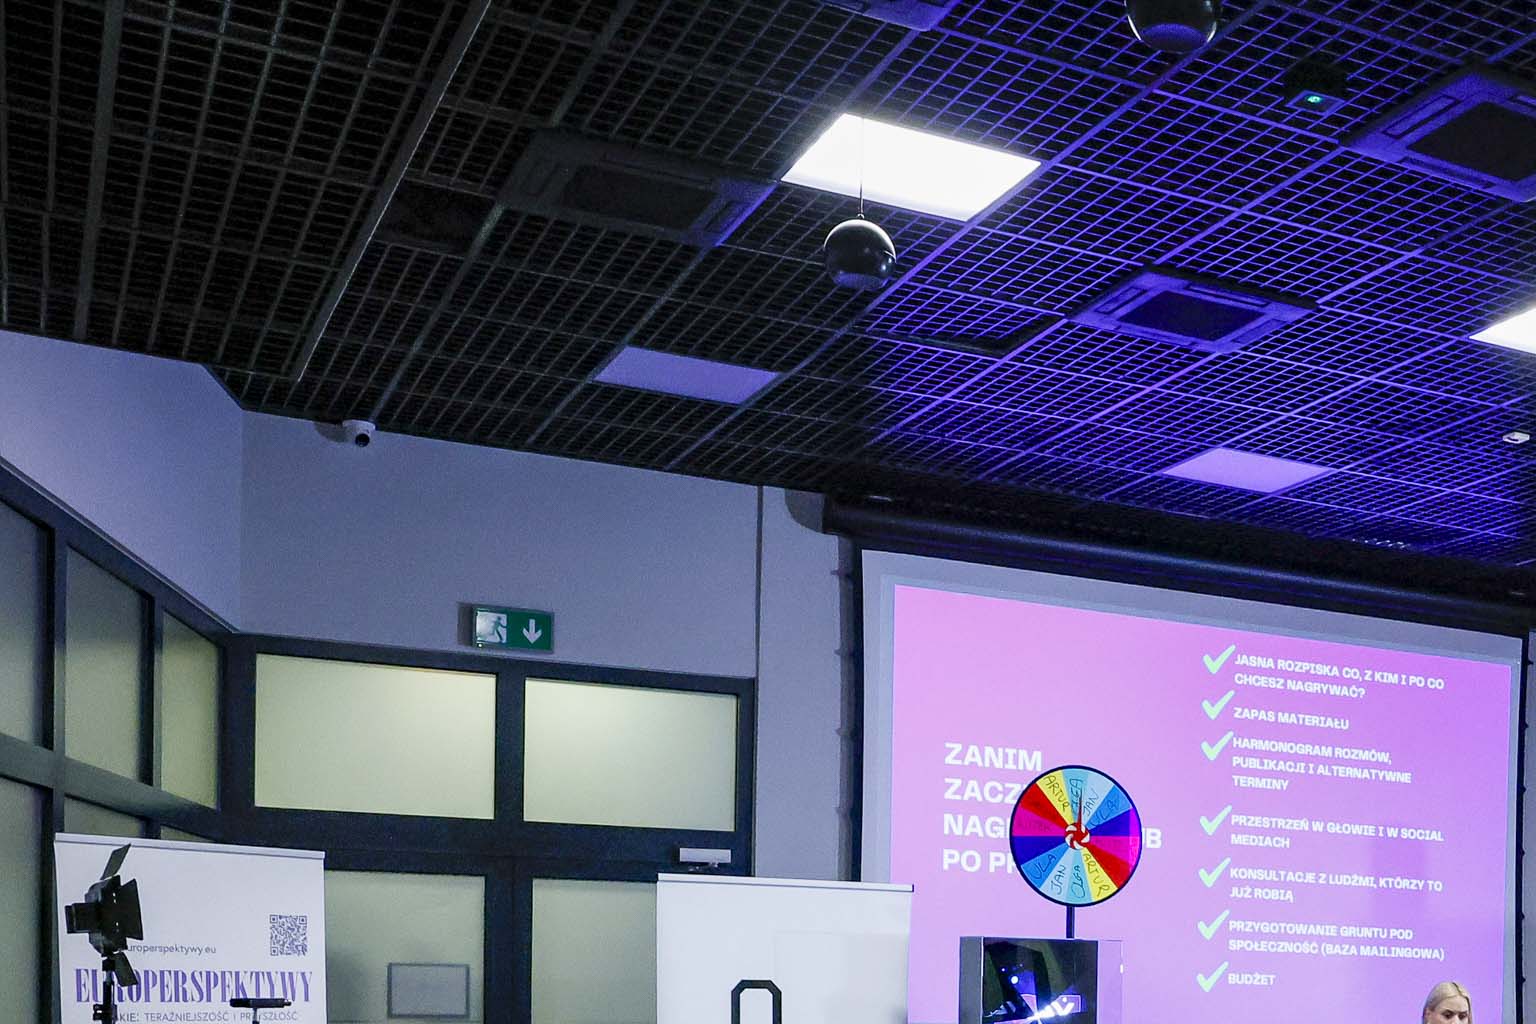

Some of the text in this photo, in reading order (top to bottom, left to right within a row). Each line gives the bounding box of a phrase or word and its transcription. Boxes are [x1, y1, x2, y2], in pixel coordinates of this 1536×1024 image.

[1234, 654, 1275, 669] JASNA
[1277, 658, 1340, 677] ROZPISKA
[1341, 667, 1363, 682] CO,
[1364, 669, 1373, 681] Z
[1374, 670, 1398, 685] KIM
[1408, 675, 1426, 688] PO
[1427, 678, 1445, 690] CO
[1234, 673, 1366, 698] CHCESZ NAGRYWAĆ?
[1233, 707, 1350, 730] ZAPAS MATERIAŁU
[944, 742, 1043, 771] ZANIM
[1232, 737, 1392, 765] HARMONOGRAM ROZMÓW,
[1232, 756, 1306, 773] PUBLIKACJI
[1316, 764, 1412, 784] ALTERNATYWNE
[1232, 774, 1289, 791] TERMINY
[1231, 814, 1309, 832] PRZESTRZEŃ
[1311, 821, 1324, 832] W
[1326, 822, 1376, 837] GŁOWIE
[1386, 826, 1399, 838] W
[1400, 828, 1445, 842] SOCIAL
[1230, 834, 1290, 849] MEDIACH
[943, 848, 982, 872] PO
[1230, 867, 1316, 884] KONSULTACJE
[1318, 872, 1327, 884] Z
[1379, 876, 1424, 891] KTÓRZY
[1426, 880, 1443, 892] TO
[1230, 886, 1293, 903] JUŻ ROBIĄ
[1229, 920, 1414, 941] PRZYGOTOWANIE GRUNTU POD
[1228, 939, 1445, 962] SPOŁECZNOŚĆ (BAZA MAILINGOWA)
[1228, 973, 1277, 986] BUDŻET
